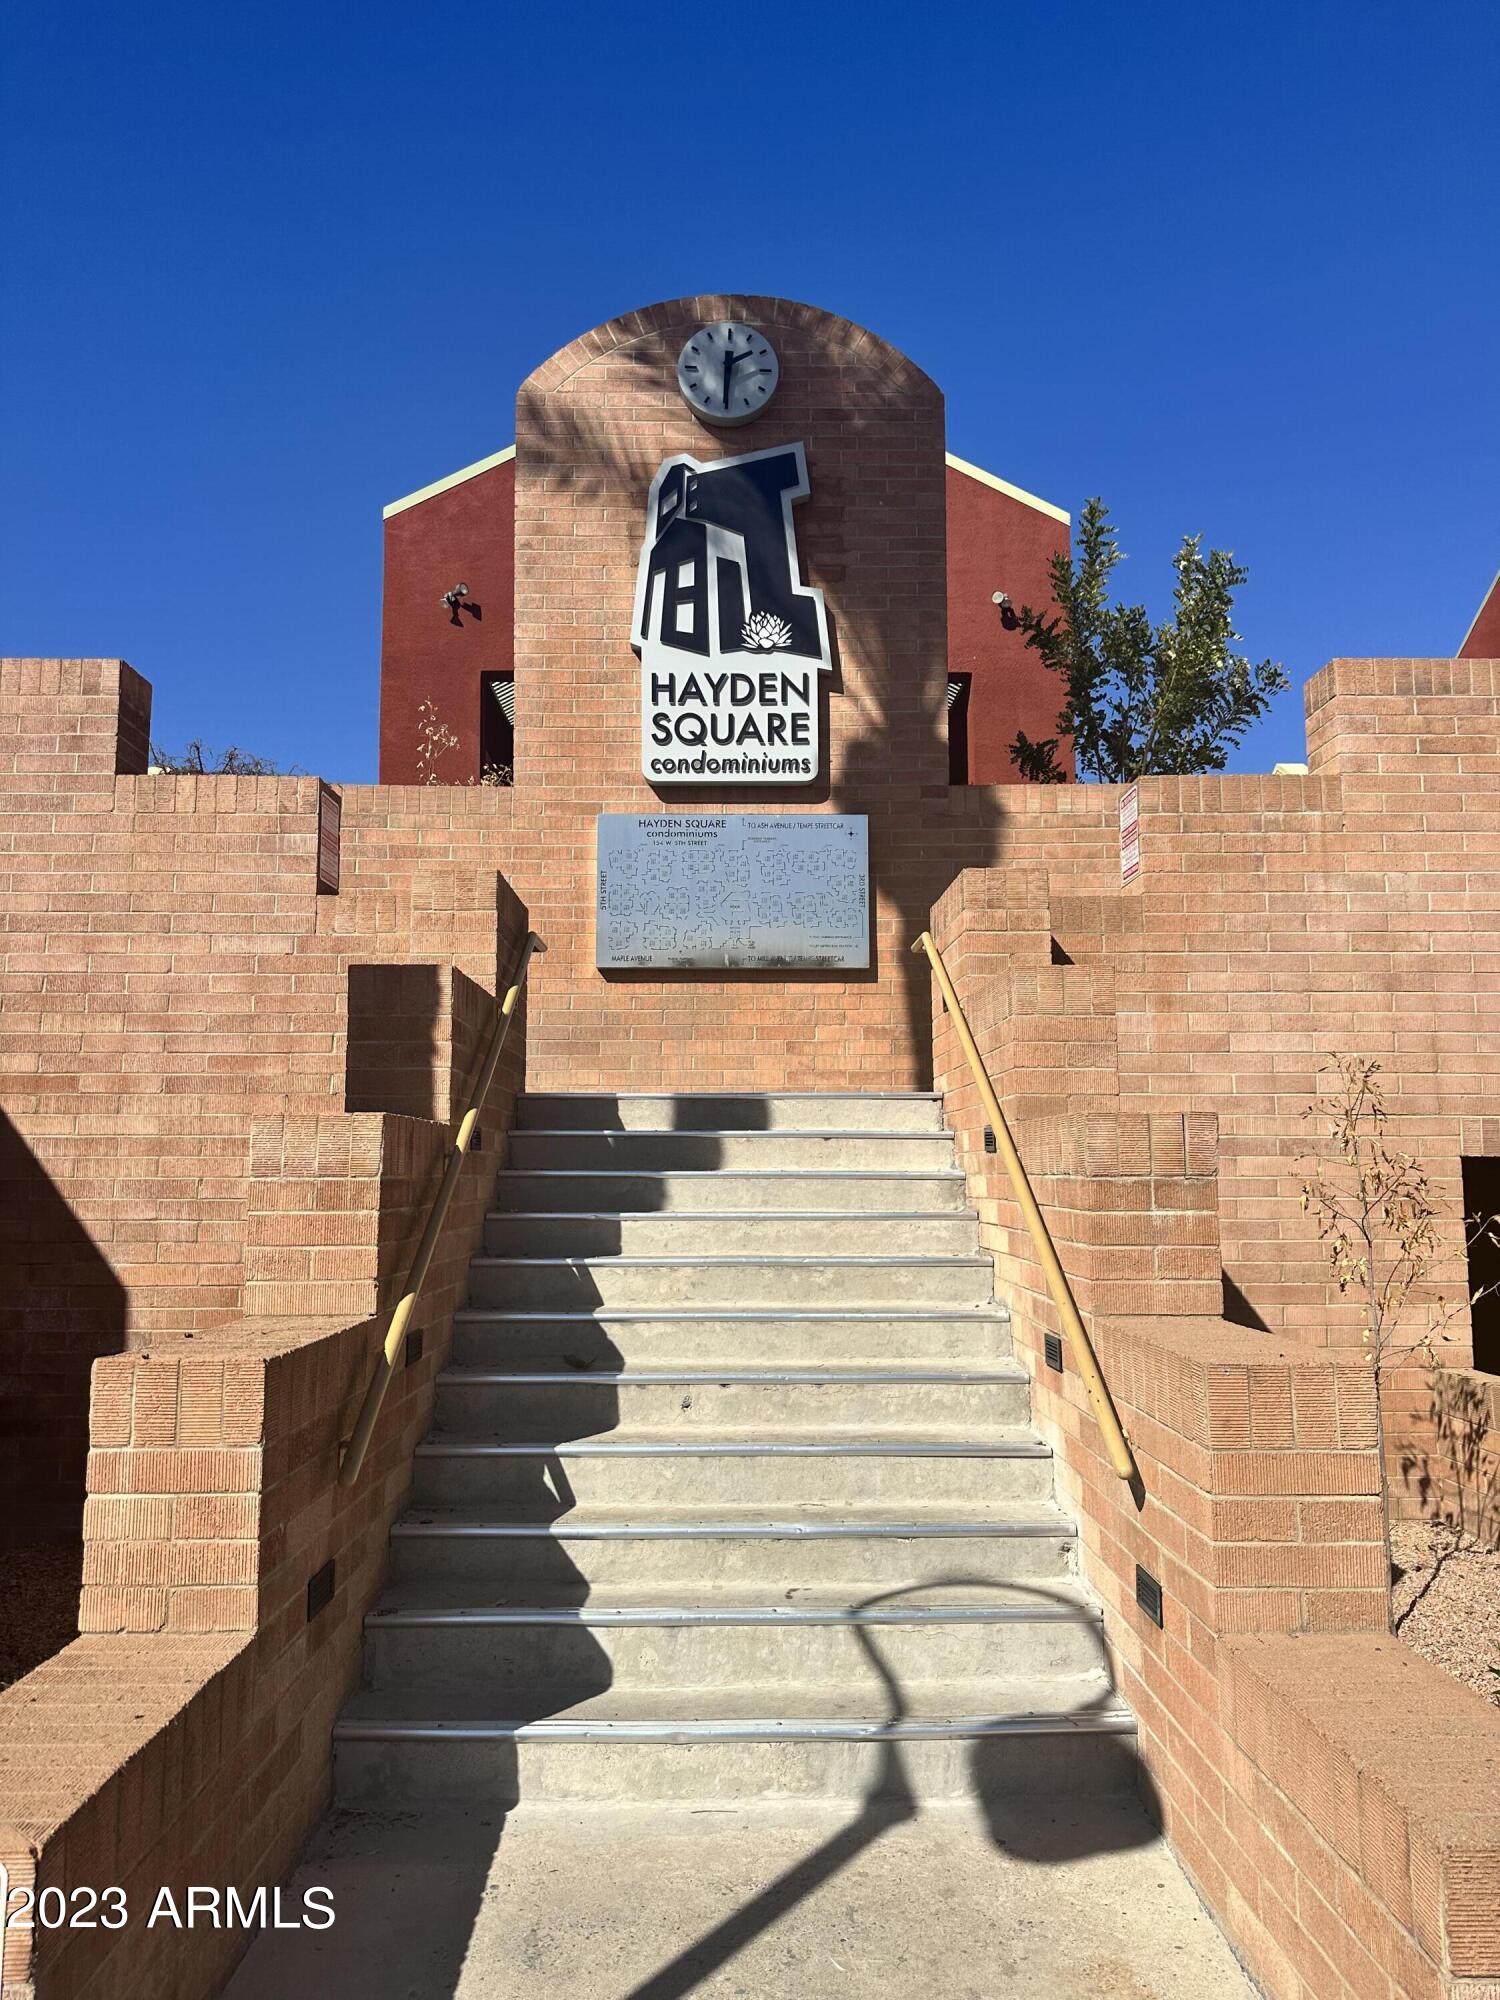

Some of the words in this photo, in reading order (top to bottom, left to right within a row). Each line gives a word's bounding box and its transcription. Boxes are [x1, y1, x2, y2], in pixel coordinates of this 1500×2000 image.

[651, 672, 810, 707] HAYDEN
[651, 712, 810, 747] SQUARE
[650, 750, 811, 774] condominiums
[638, 819, 682, 829] HAYDEN
[685, 819, 727, 829] SQUARE
[815, 822, 844, 830] STREETCAR
[646, 829, 718, 838] condominiums
[858, 874, 866, 886] 3RD
[858, 887, 866, 908] STREET
